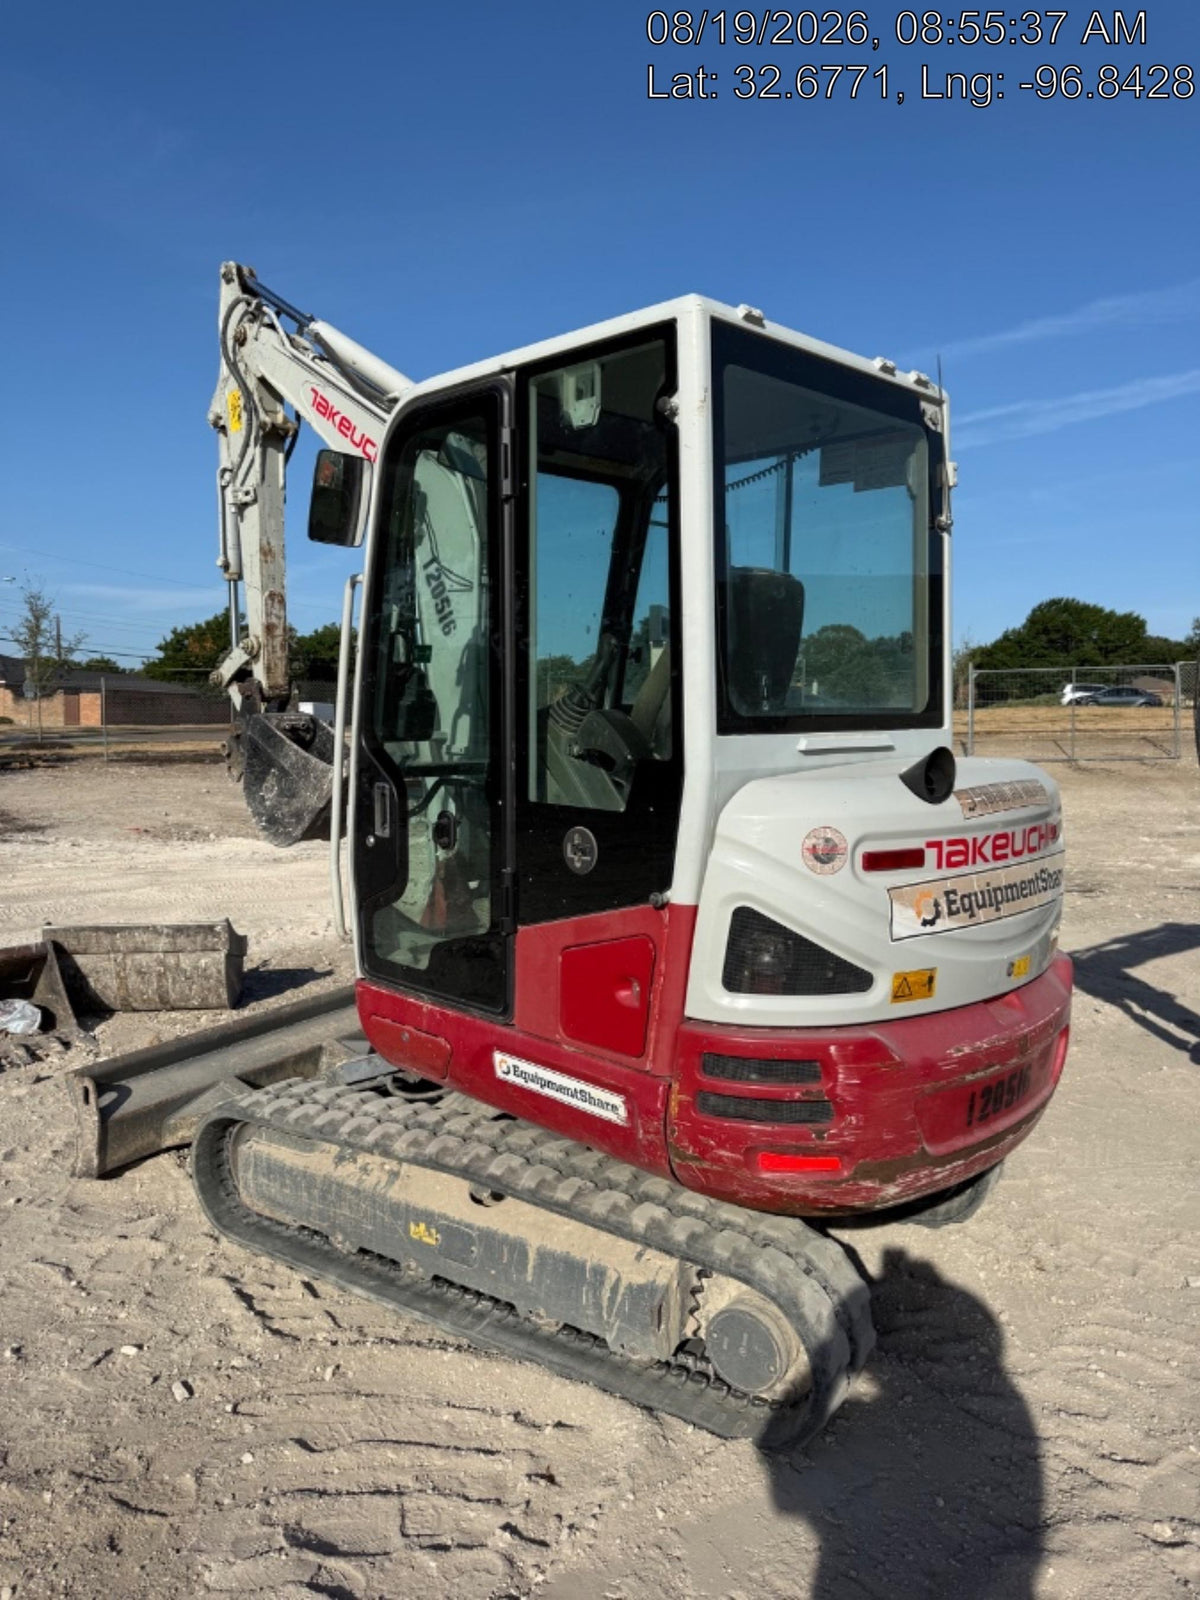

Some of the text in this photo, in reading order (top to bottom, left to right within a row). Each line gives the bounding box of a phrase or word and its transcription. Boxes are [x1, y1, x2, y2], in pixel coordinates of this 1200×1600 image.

[310, 387, 378, 464] TAKEUC
[943, 867, 1063, 918] EquipmentShar
[511, 1064, 620, 1115] EquipmentShare
